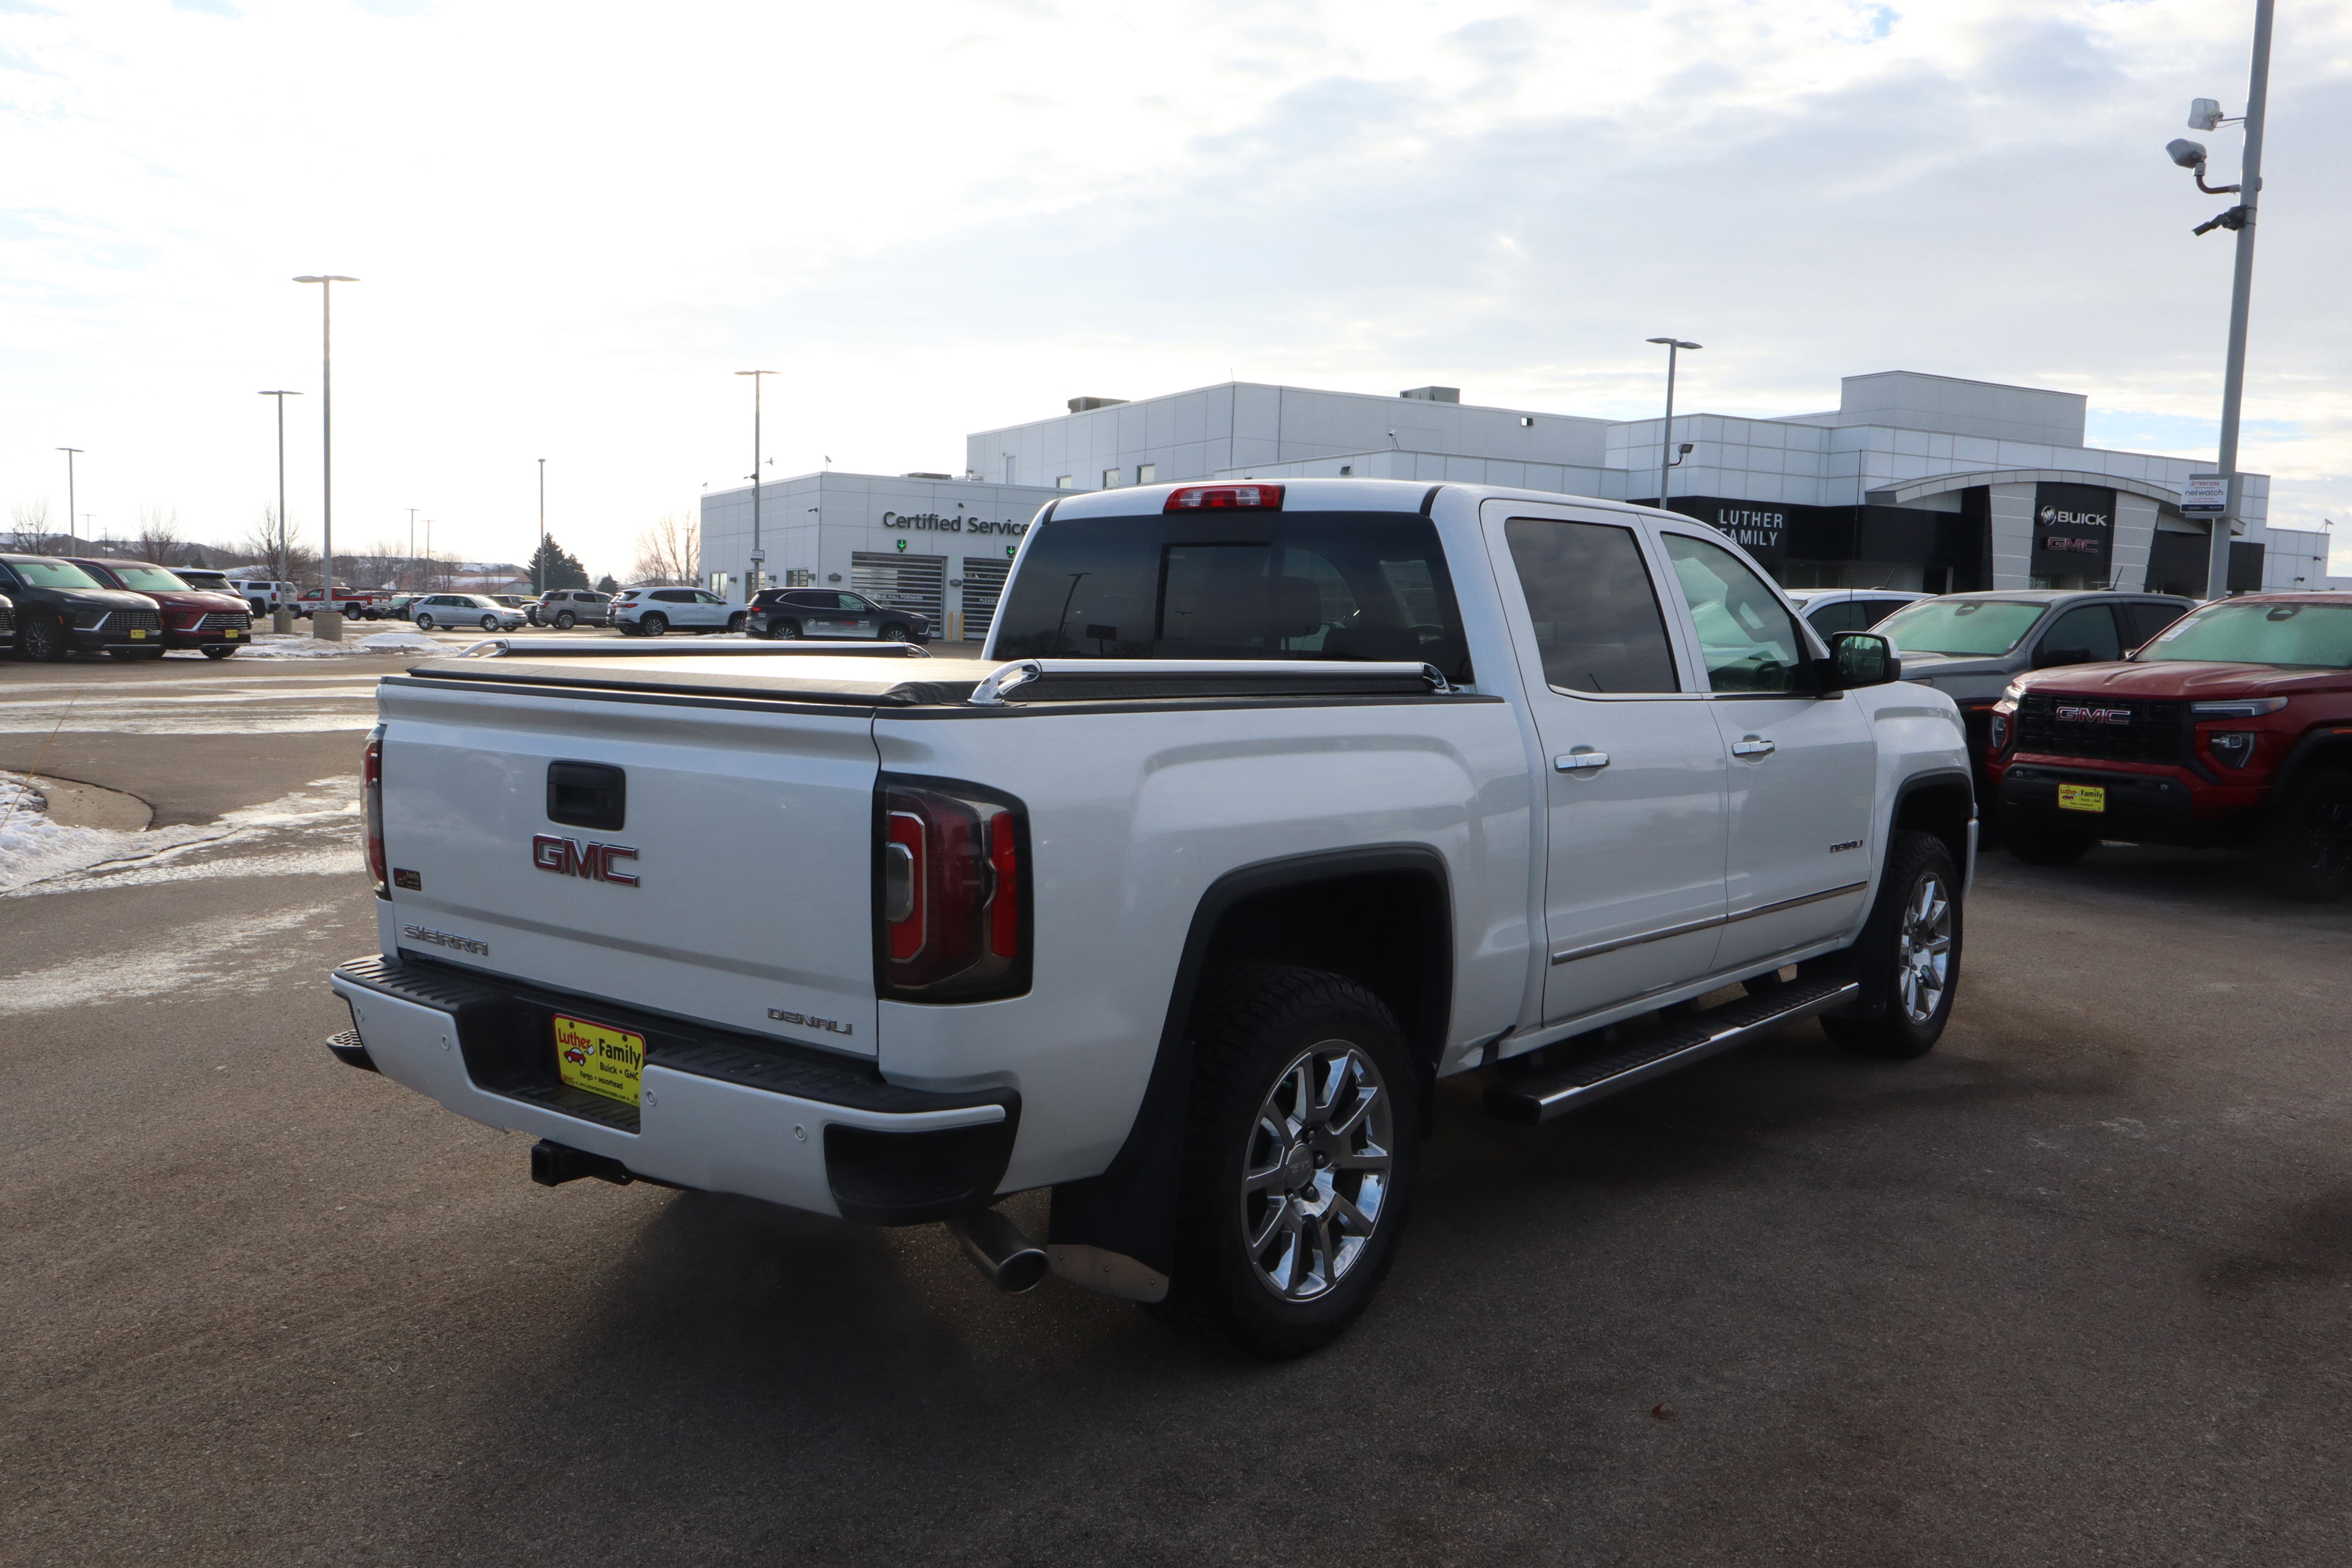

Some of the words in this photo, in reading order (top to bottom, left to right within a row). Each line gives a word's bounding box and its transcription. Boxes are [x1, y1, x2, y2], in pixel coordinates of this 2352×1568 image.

[883, 511, 962, 531] Certified
[968, 517, 1029, 535] Service
[1719, 509, 1783, 528] LUTHER
[2057, 511, 2108, 526] BUICK
[2047, 537, 2098, 553] GMC
[2056, 706, 2131, 725] GMC
[2081, 790, 2103, 799] Family
[1830, 838, 1863, 854] DENALI
[533, 833, 640, 888] GMC
[404, 923, 488, 956] SIERRA
[767, 1007, 852, 1035] DENALI
[558, 1028, 591, 1049] Luther
[599, 1038, 641, 1071] Family
[580, 1071, 593, 1081] Fargo
[598, 1076, 623, 1089] Moorhead
[600, 1062, 618, 1075] Buick
[625, 1069, 639, 1081] GMC
